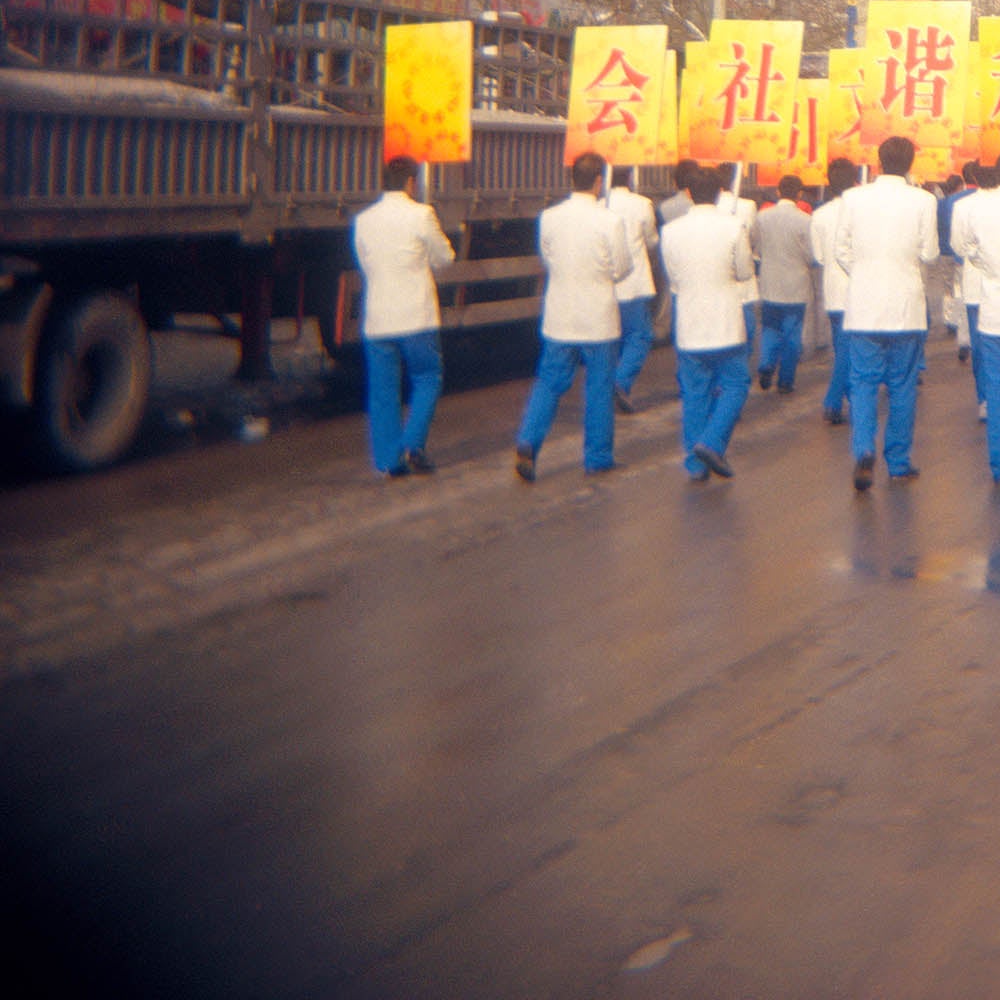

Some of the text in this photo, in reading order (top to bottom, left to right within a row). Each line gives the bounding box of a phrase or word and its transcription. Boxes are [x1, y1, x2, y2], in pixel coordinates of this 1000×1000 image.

[586, 48, 650, 134] 会
[718, 43, 785, 130] 社
[880, 26, 956, 118] 谐
